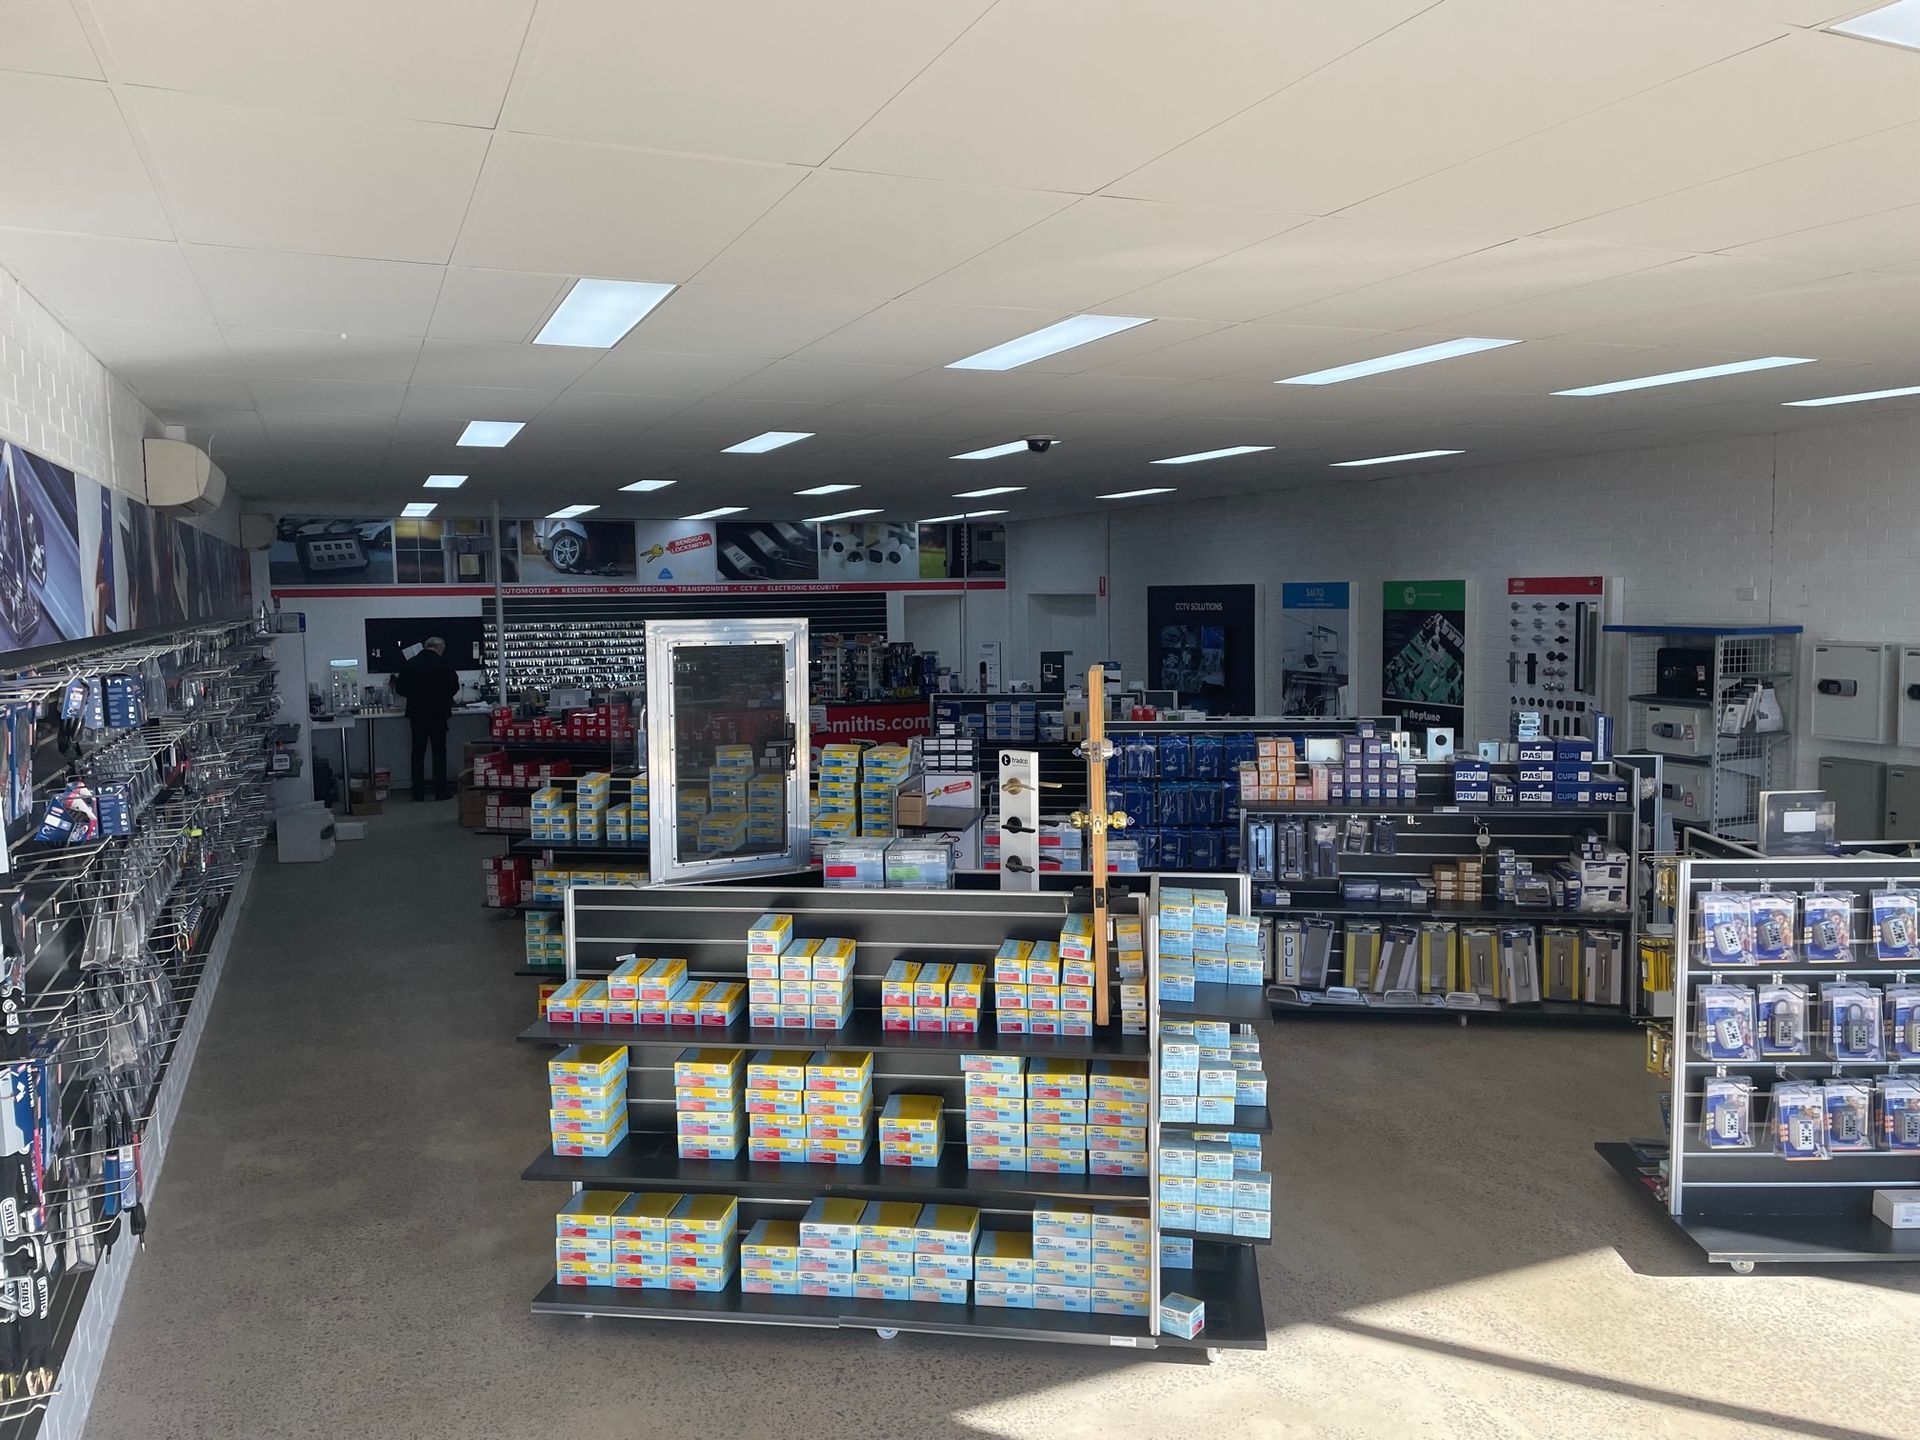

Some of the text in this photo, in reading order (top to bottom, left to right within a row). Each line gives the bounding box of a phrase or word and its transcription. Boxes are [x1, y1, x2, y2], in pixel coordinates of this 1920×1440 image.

[672, 540, 710, 552] LOCKSMITHS
[675, 536, 703, 546] BENDIGO
[1176, 602, 1223, 610] CCTV SOLUTIONS
[4, 1204, 16, 1234] ABUS
[20, 1282, 31, 1311] ABUS
